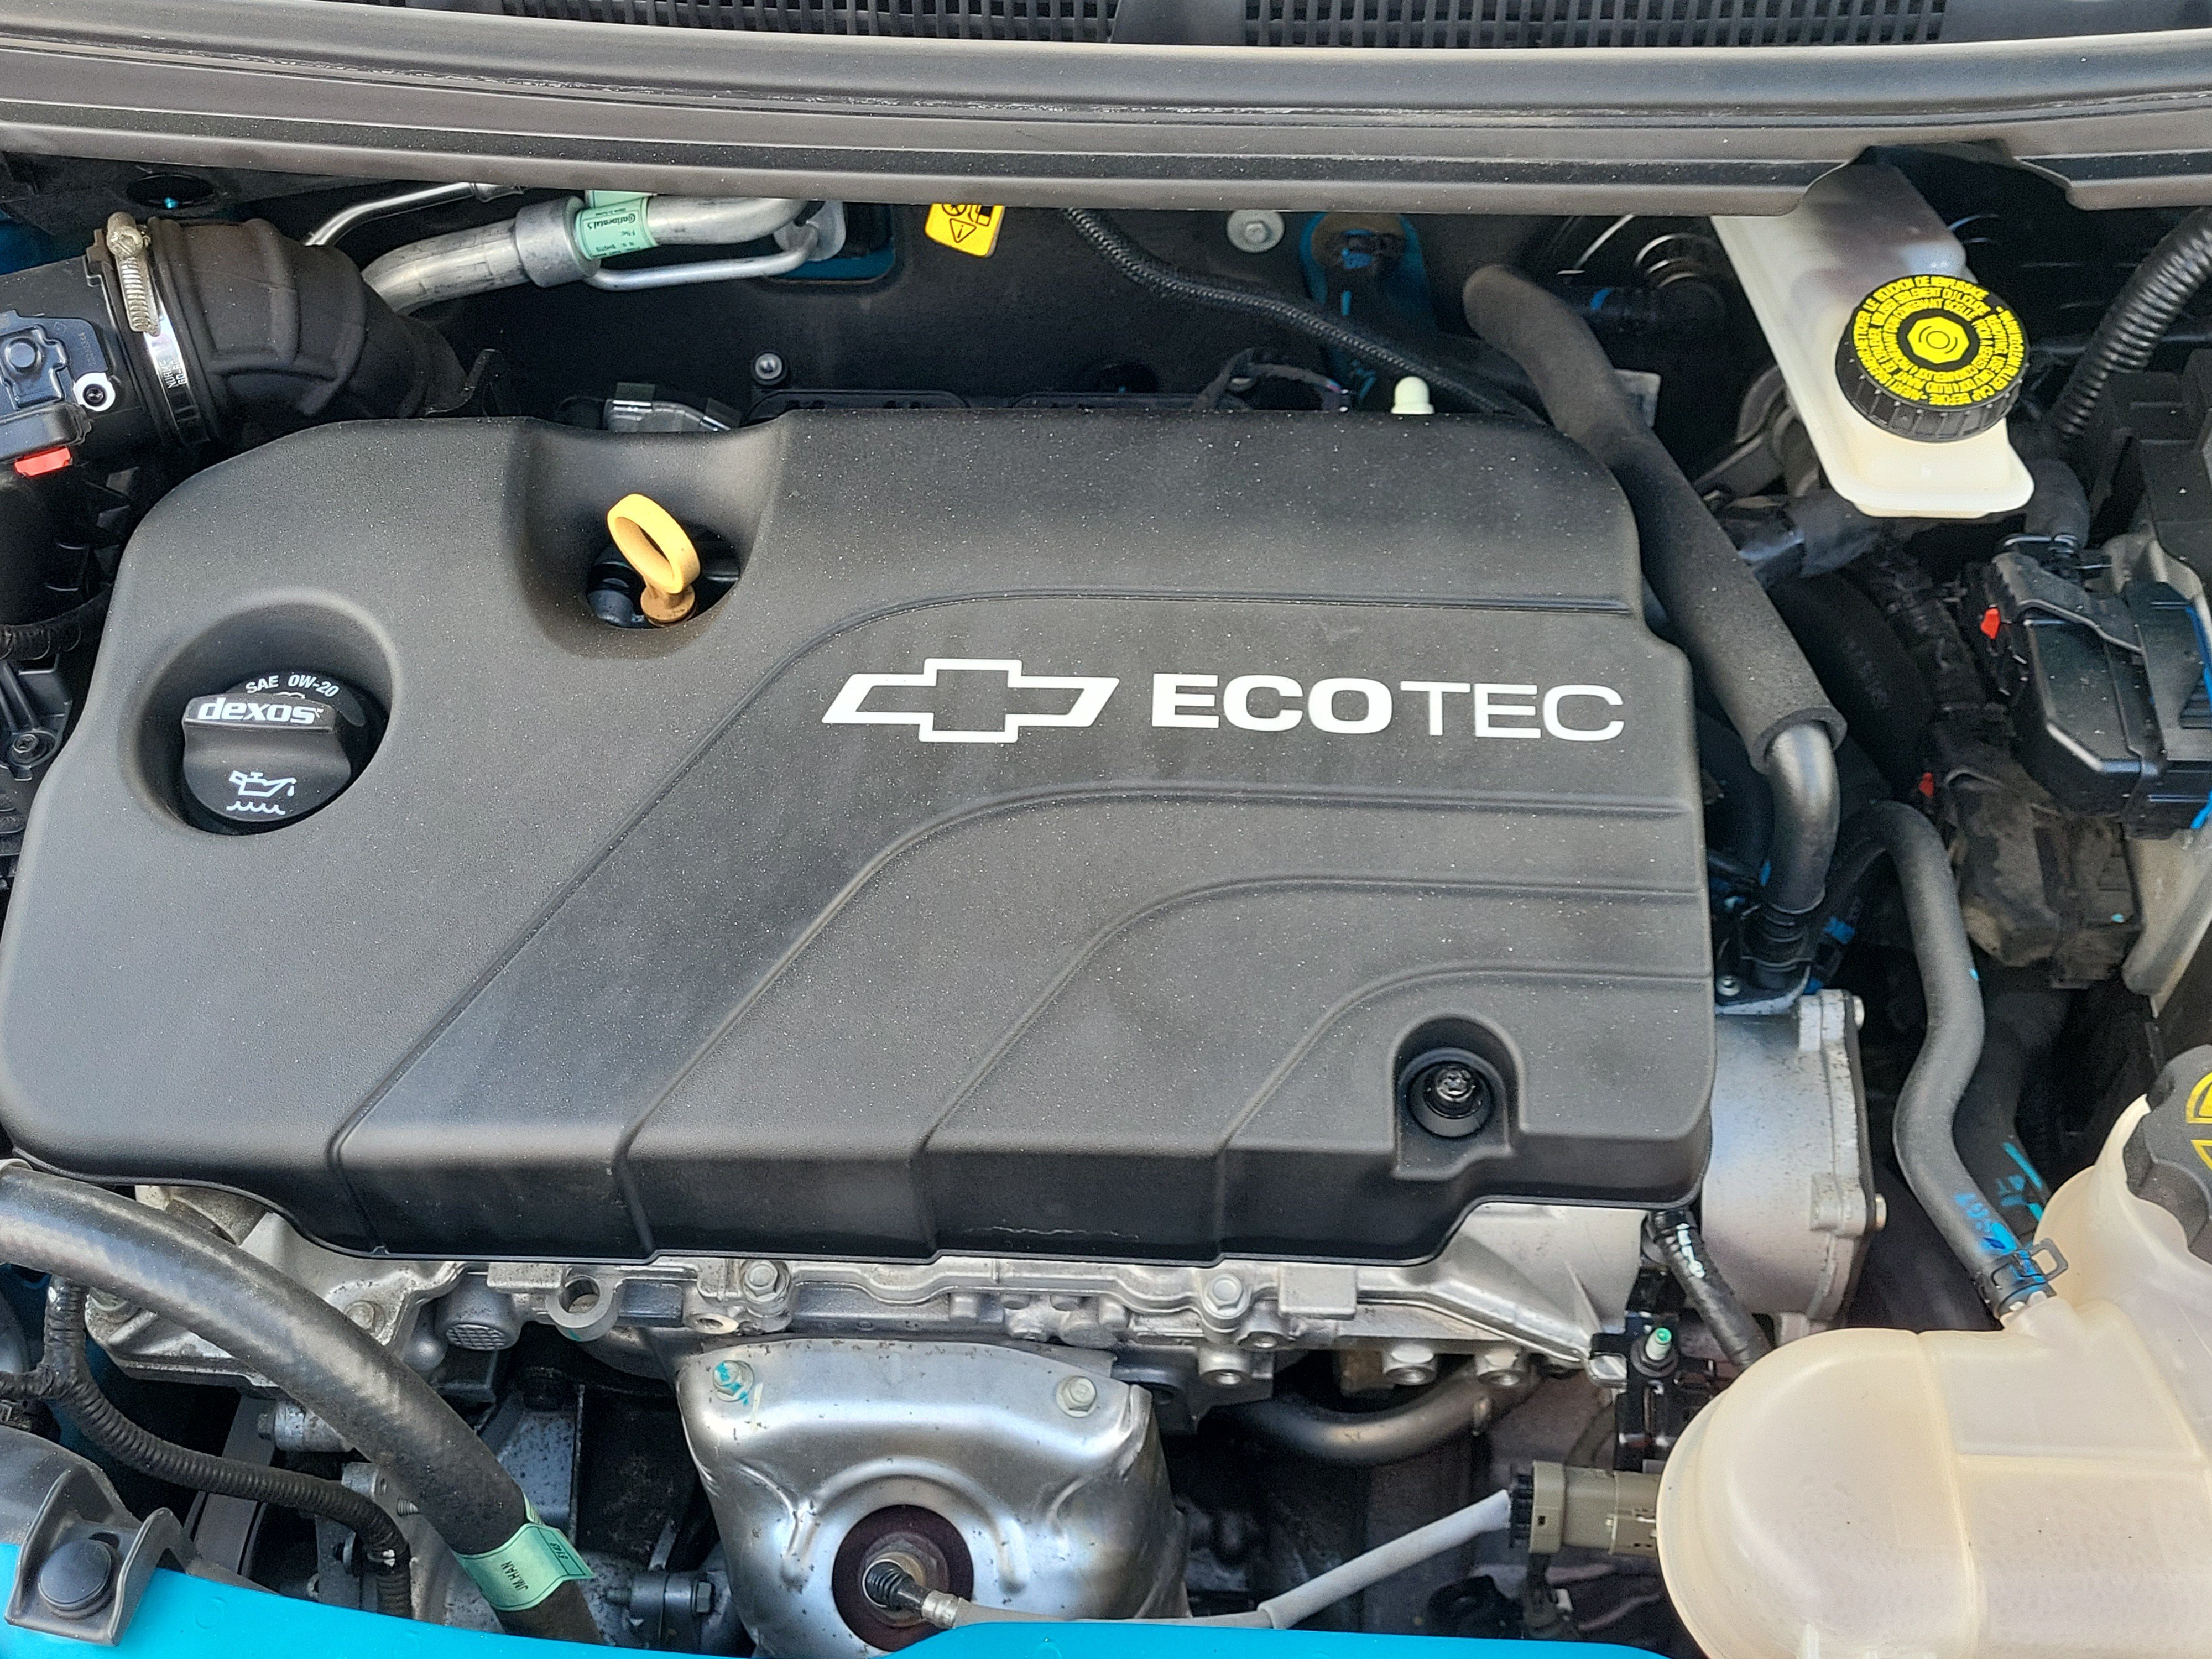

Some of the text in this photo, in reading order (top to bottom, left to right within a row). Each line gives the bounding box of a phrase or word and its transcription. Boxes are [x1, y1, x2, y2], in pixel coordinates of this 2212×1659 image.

[1972, 385, 1995, 401] CAP
[245, 674, 340, 697] SAE 0W-20
[197, 697, 315, 724] dexos
[1151, 672, 1625, 742] ECOTEC
